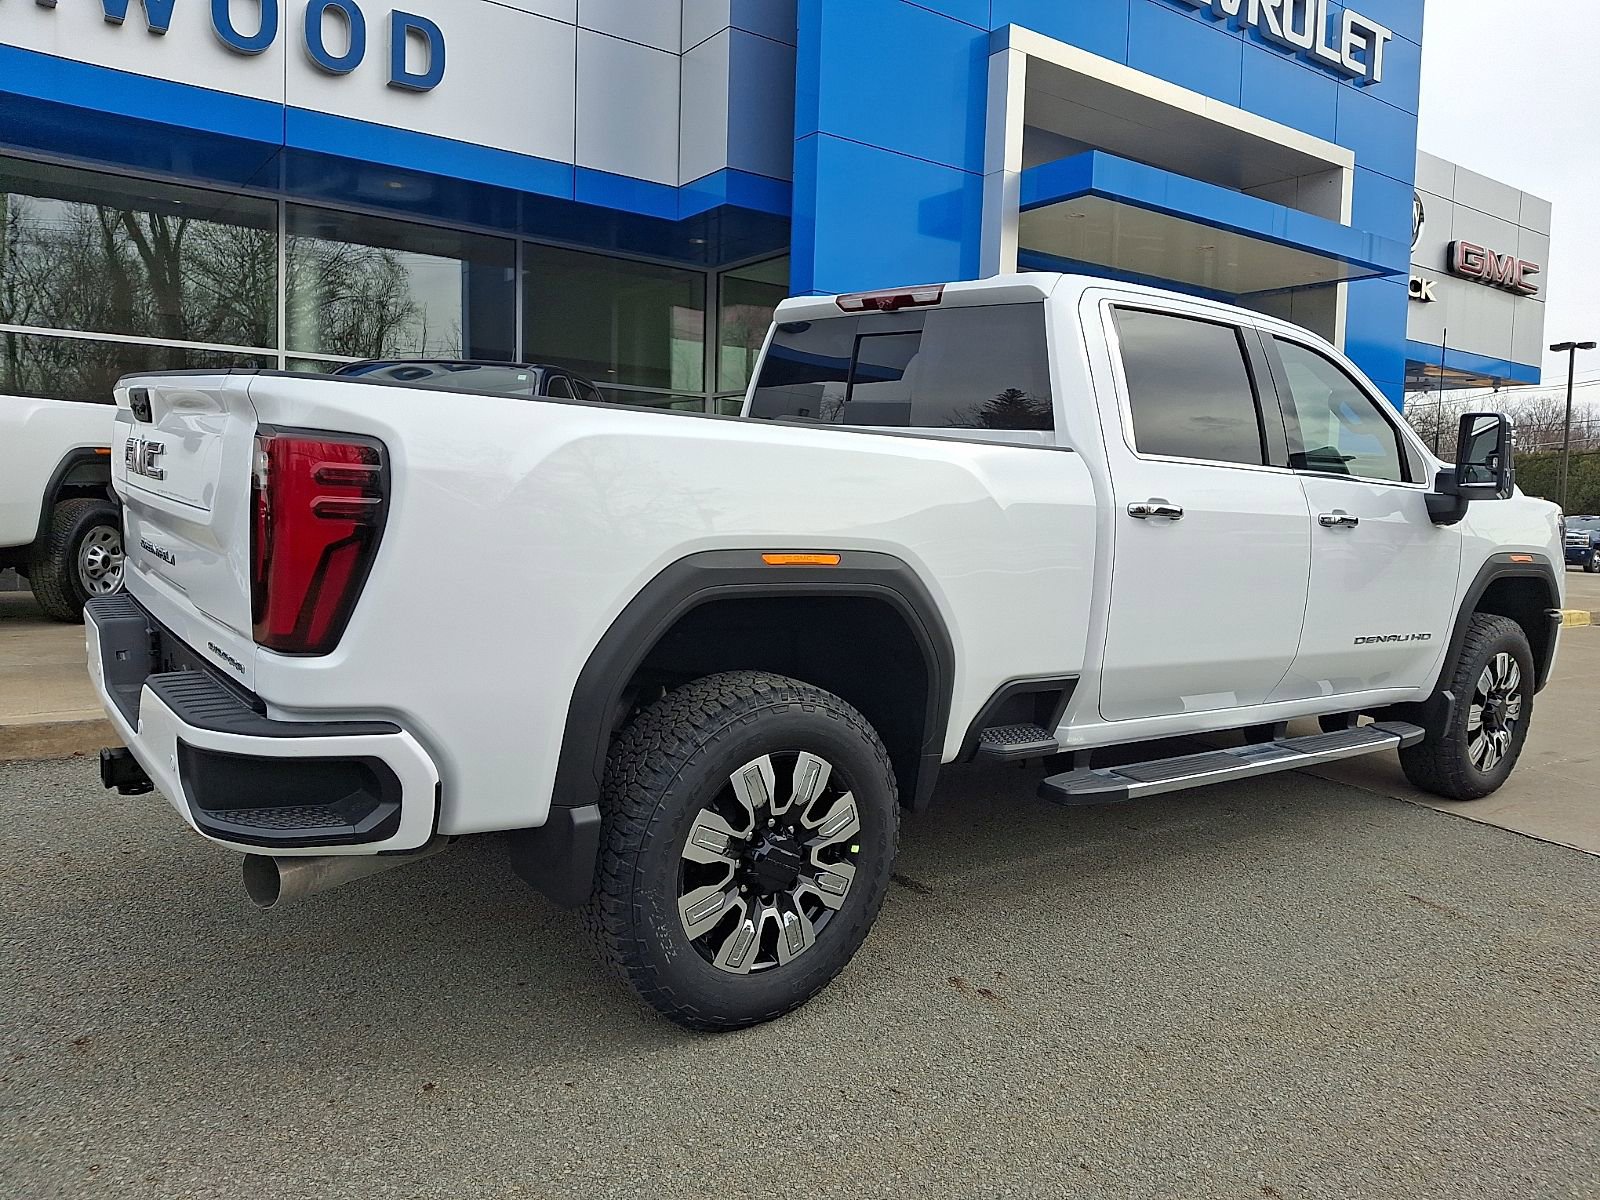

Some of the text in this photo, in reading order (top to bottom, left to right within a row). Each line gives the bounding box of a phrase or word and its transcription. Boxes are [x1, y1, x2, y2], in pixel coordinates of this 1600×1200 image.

[35, 0, 446, 92] OOD
[1458, 240, 1540, 293] GMC
[1353, 632, 1432, 645] DENALI HD
